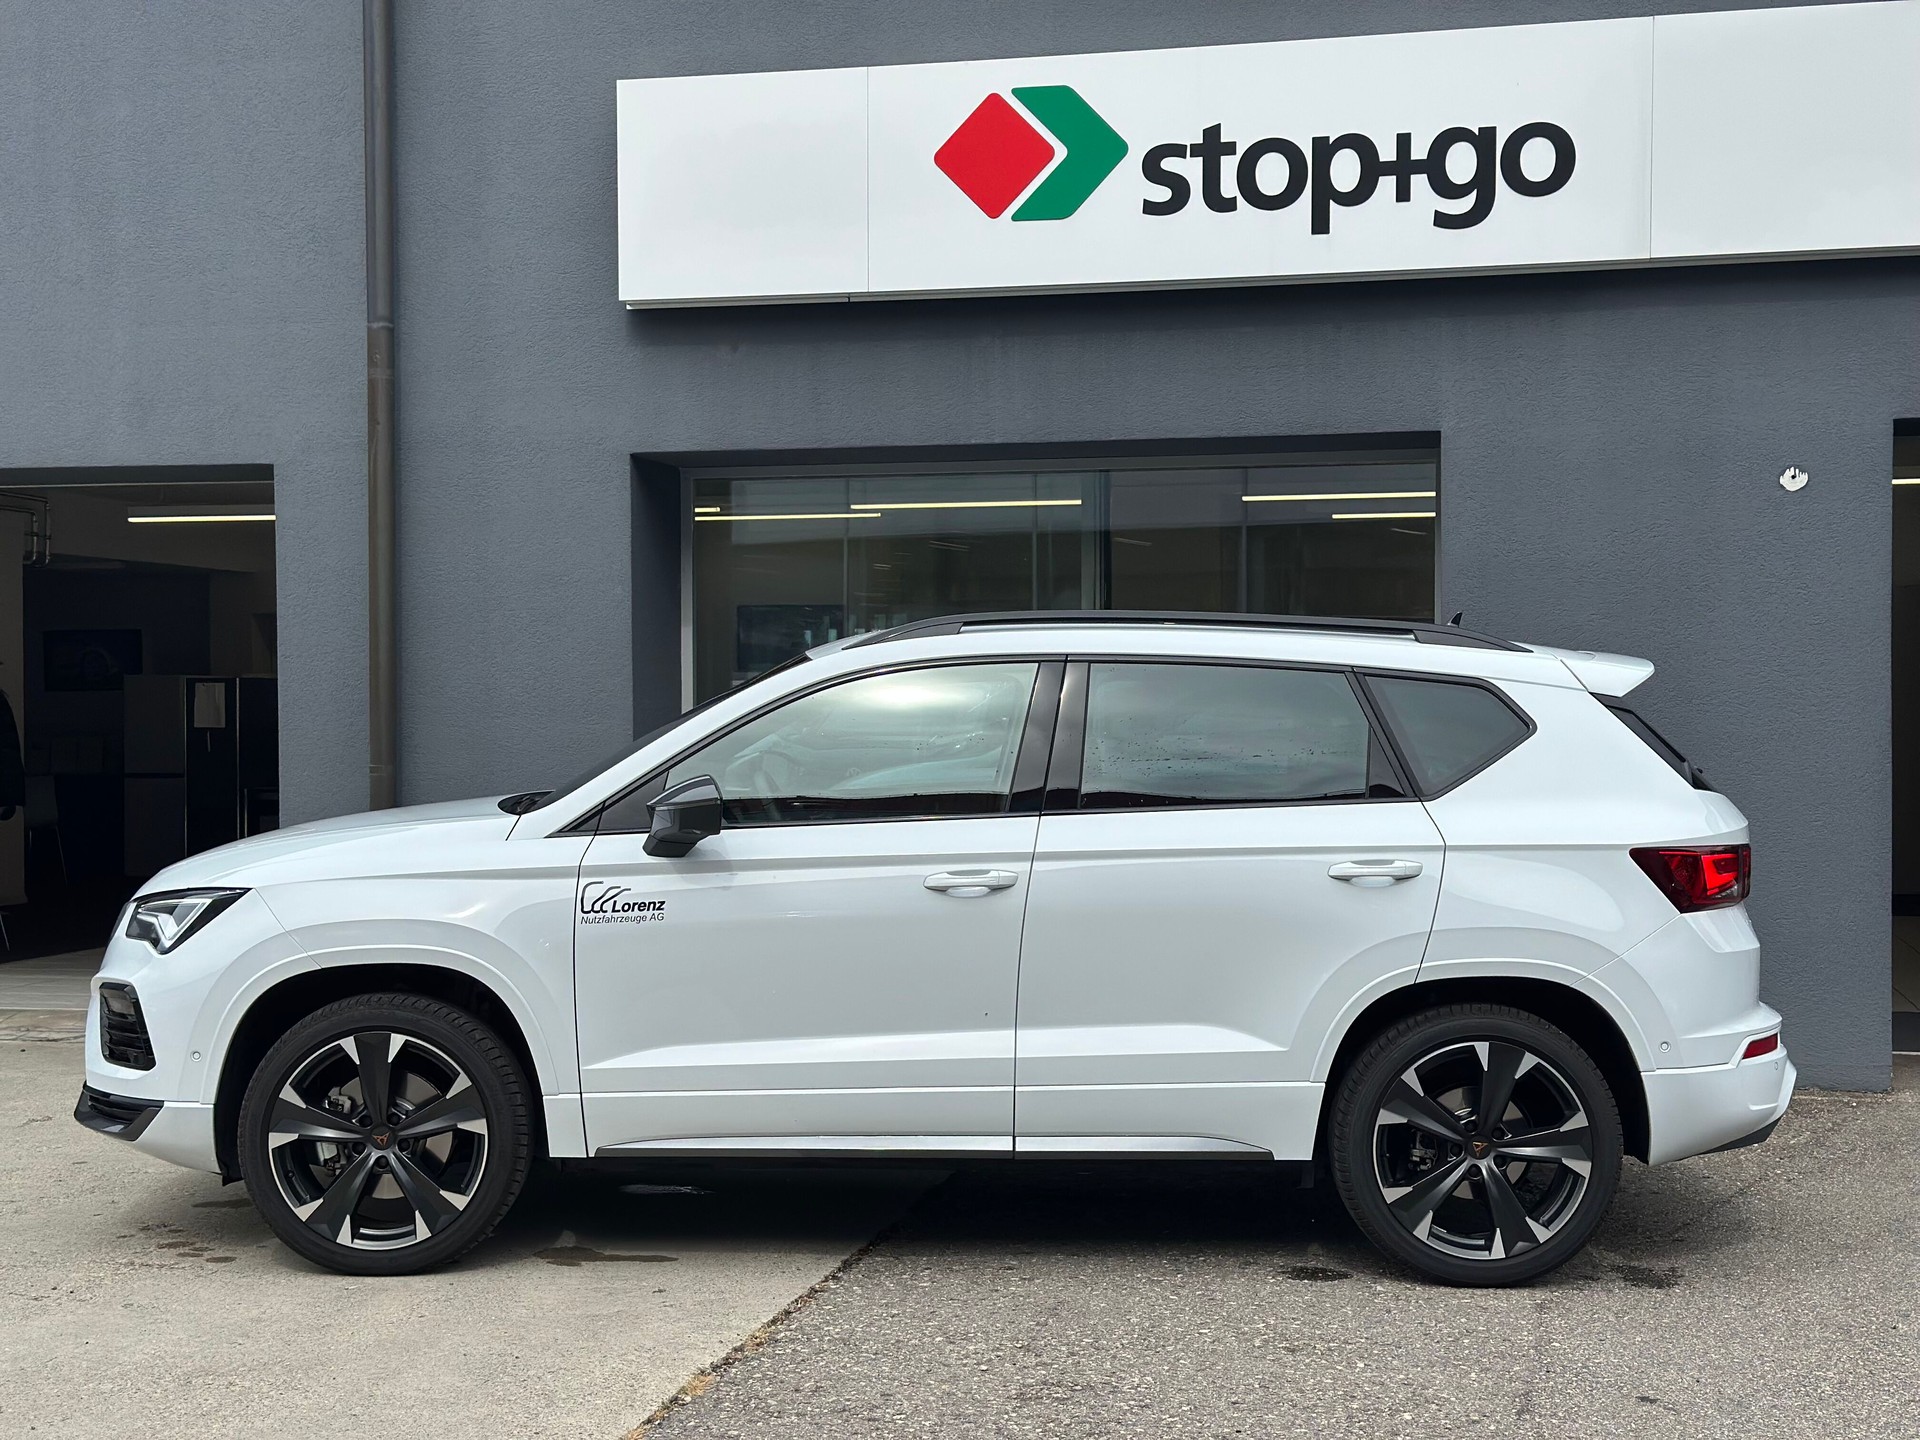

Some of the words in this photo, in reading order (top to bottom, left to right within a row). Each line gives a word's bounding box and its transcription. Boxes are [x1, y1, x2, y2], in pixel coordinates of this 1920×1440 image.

[1142, 121, 1577, 235] stop+go
[611, 899, 666, 913] Lorenz
[580, 914, 648, 924] Nutzfahrzeuge
[649, 912, 665, 921] AG
